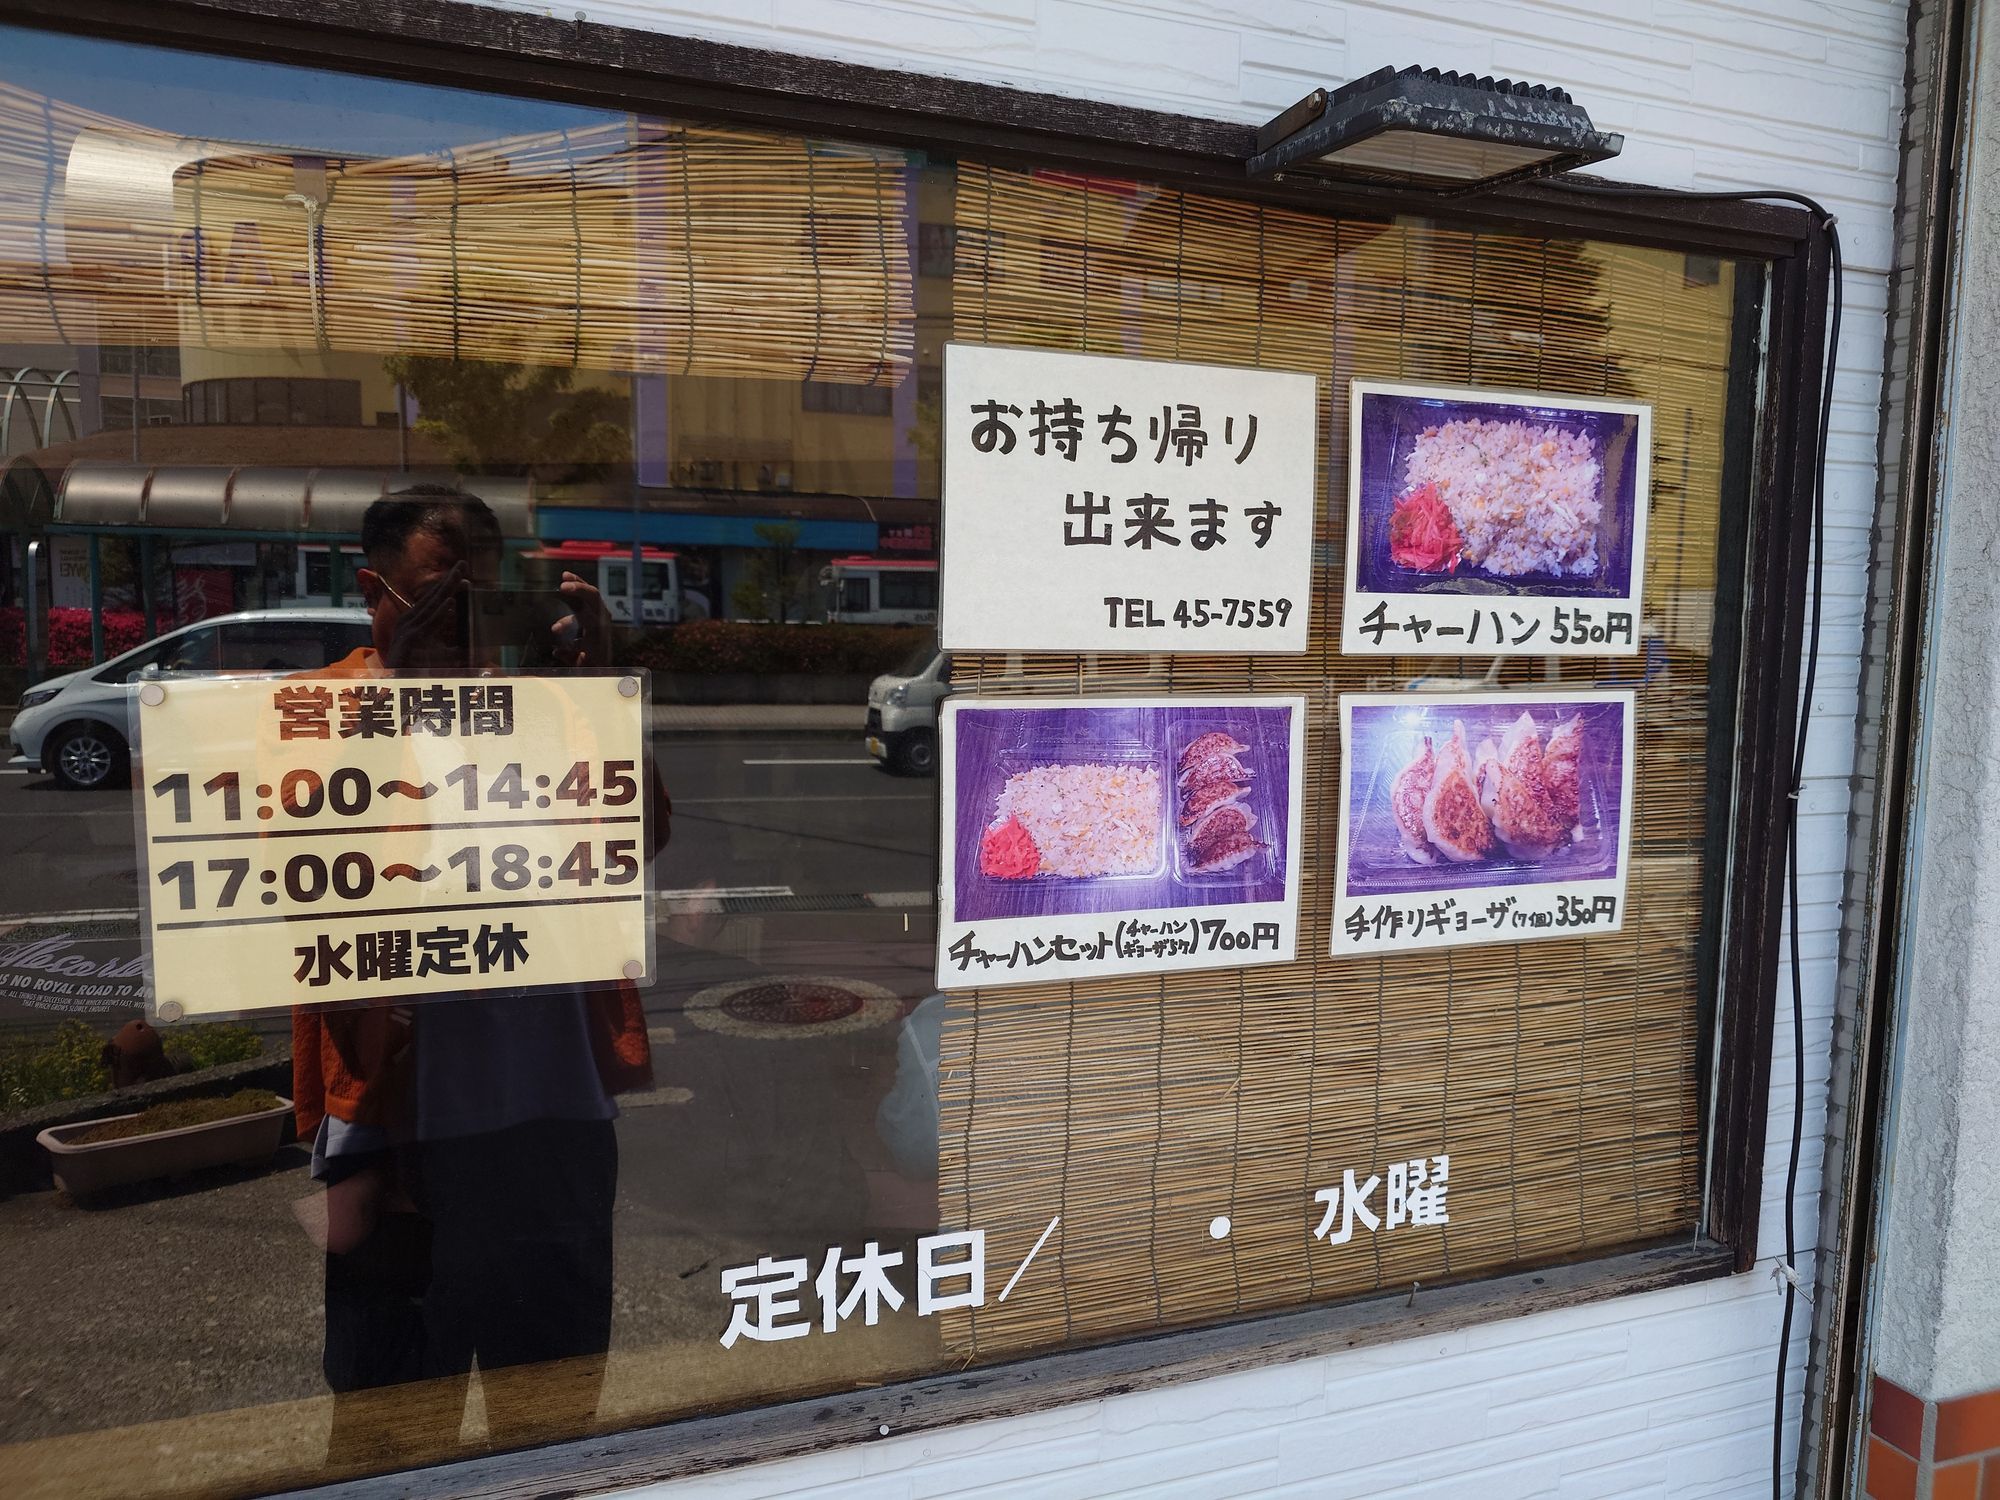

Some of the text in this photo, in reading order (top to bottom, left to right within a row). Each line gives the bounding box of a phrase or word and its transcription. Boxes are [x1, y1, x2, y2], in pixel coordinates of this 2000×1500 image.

[970, 397, 1259, 466] お持ち帰り
[1063, 491, 1282, 551] 出来ます
[1104, 597, 1293, 629] TEL 45-7559
[1358, 600, 1633, 646] チャーハン 550円
[273, 684, 515, 741] 営業時間
[294, 922, 530, 987] 水曜定休
[10, 975, 32, 988] NO
[33, 978, 75, 995] ROYAL
[76, 983, 114, 996] ROAD
[115, 985, 133, 996] TO
[1313, 1154, 1450, 1246] 水曜
